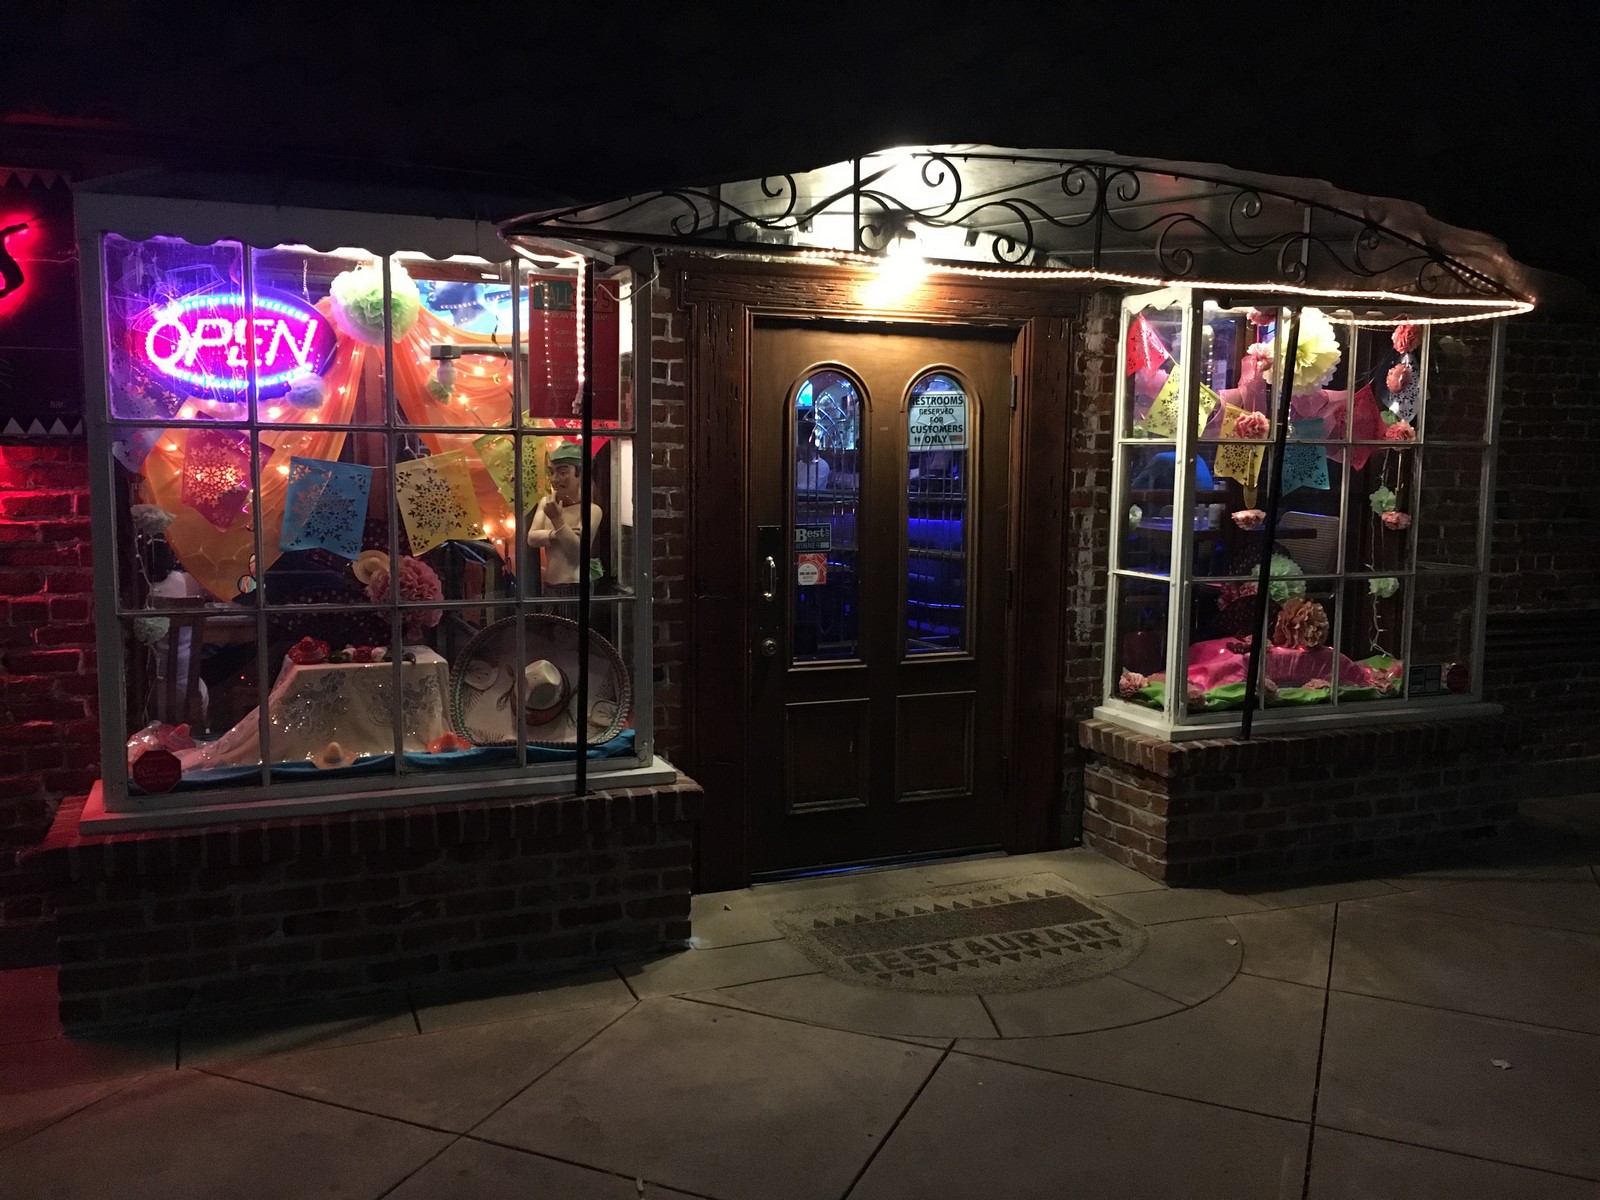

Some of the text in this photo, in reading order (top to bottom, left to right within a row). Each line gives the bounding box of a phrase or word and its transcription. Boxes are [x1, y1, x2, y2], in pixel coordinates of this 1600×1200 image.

[145, 317, 318, 372] OPEN
[911, 425, 963, 434] CUSTOMERS
[925, 435, 947, 443] ONLY
[795, 527, 824, 543] Best
[844, 920, 1122, 975] RESTAURANT
